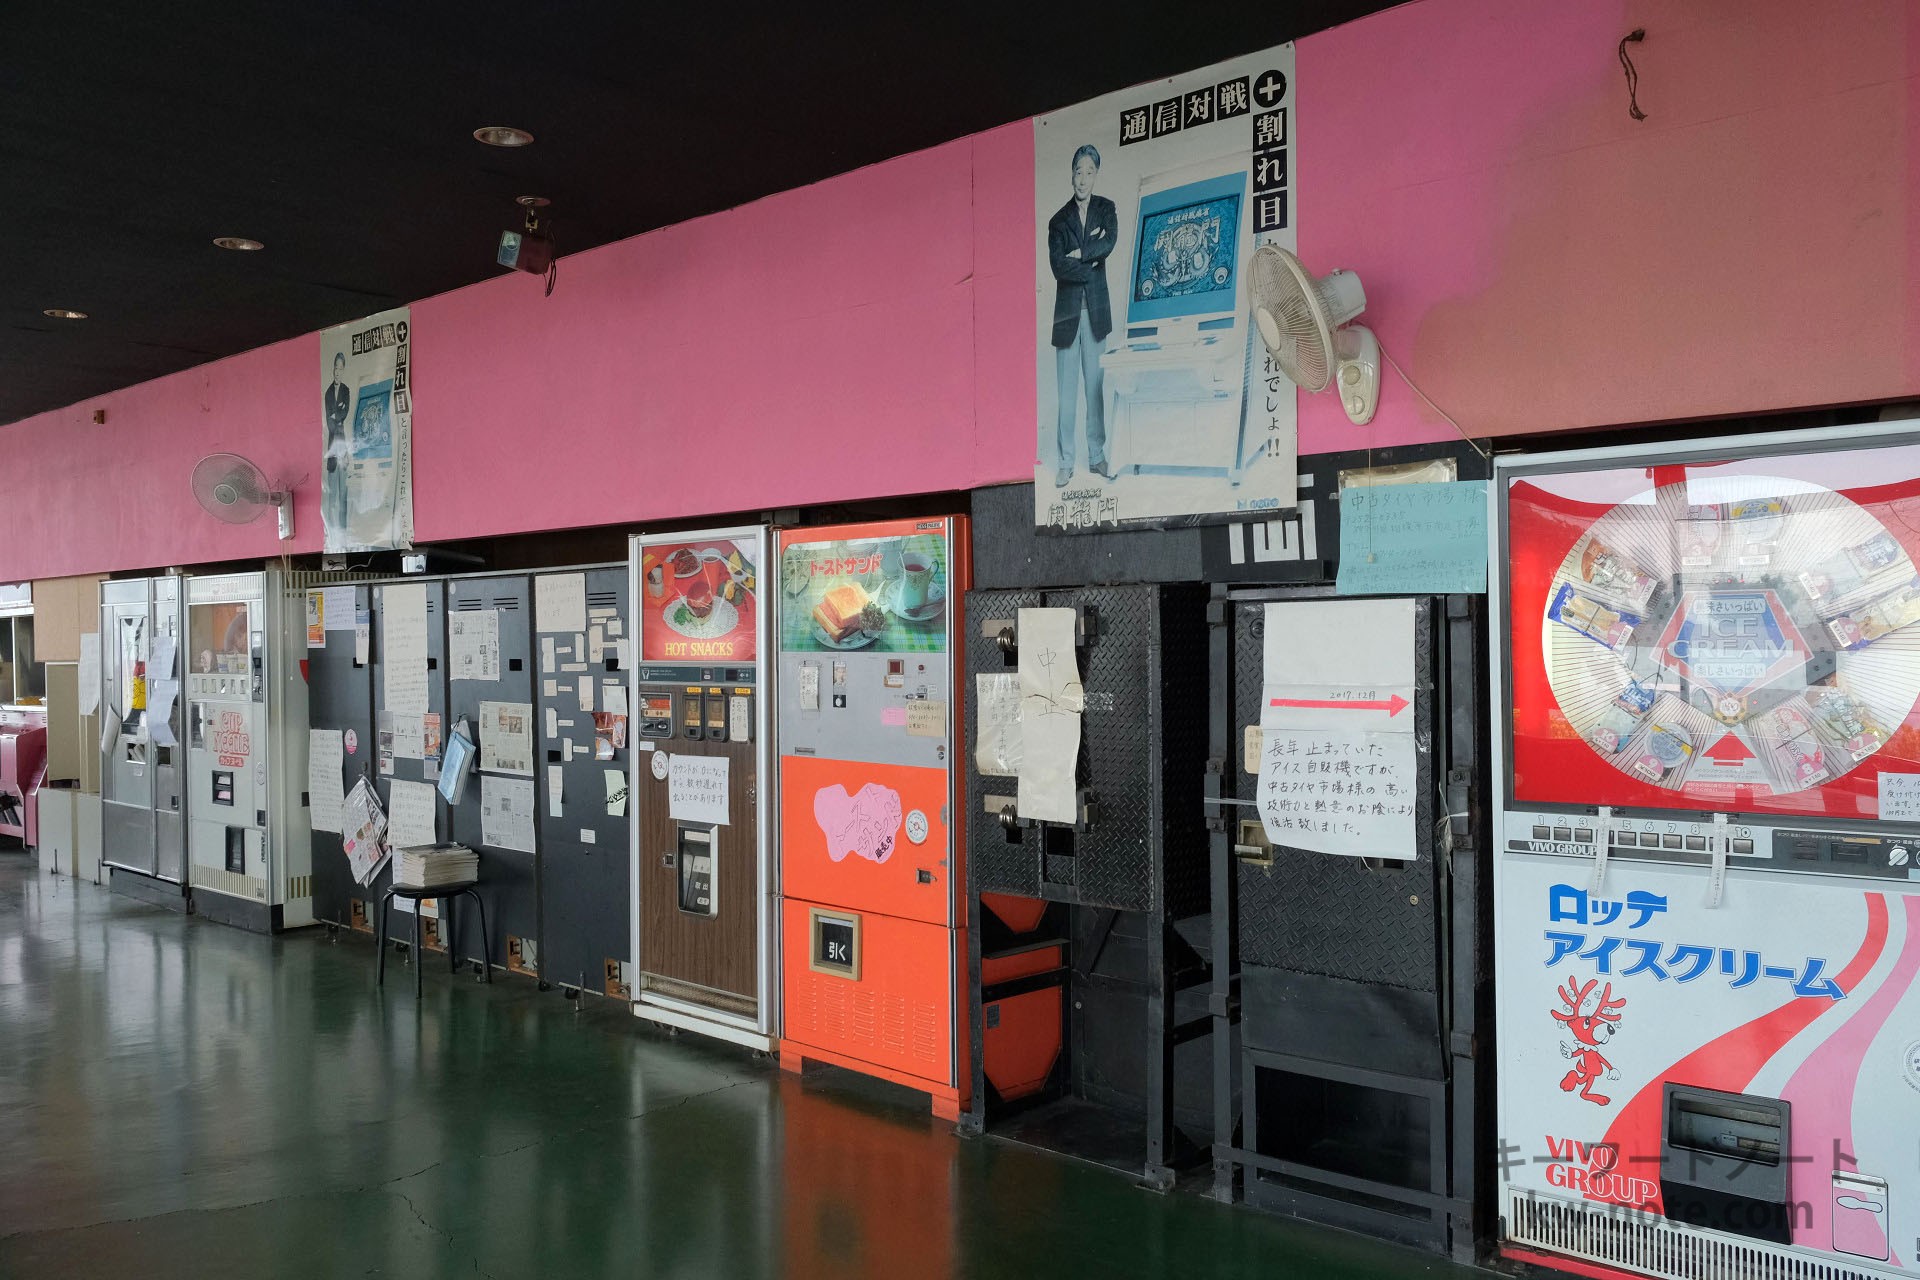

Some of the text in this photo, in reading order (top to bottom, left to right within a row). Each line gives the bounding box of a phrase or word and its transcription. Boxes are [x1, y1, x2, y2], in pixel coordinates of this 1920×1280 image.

[1120, 78, 1250, 145] 通信対戦
[1254, 110, 1286, 231] 割れ目
[1263, 347, 1280, 457] れでしょ!!
[810, 553, 883, 577] トーストサンド
[1702, 618, 1758, 637] ICE
[664, 642, 733, 656] HOT SNACKS
[1668, 639, 1794, 659] CREAM
[1802, 763, 1814, 775] 8
[1538, 815, 1546, 826] 1
[1558, 816, 1567, 827] 2
[1579, 817, 1588, 828] 3
[1622, 820, 1632, 831] 5
[1645, 822, 1654, 832] 6
[1667, 823, 1677, 833] 7
[1690, 824, 1700, 835] 8
[1735, 827, 1751, 838] 10
[1528, 841, 1598, 856] VIVO GROUP
[1550, 884, 1667, 929] ロッテ
[1544, 930, 1847, 1000] アイスクリーム
[1545, 1135, 1619, 1170] VIVO
[1545, 1163, 1658, 1205] GROUP
